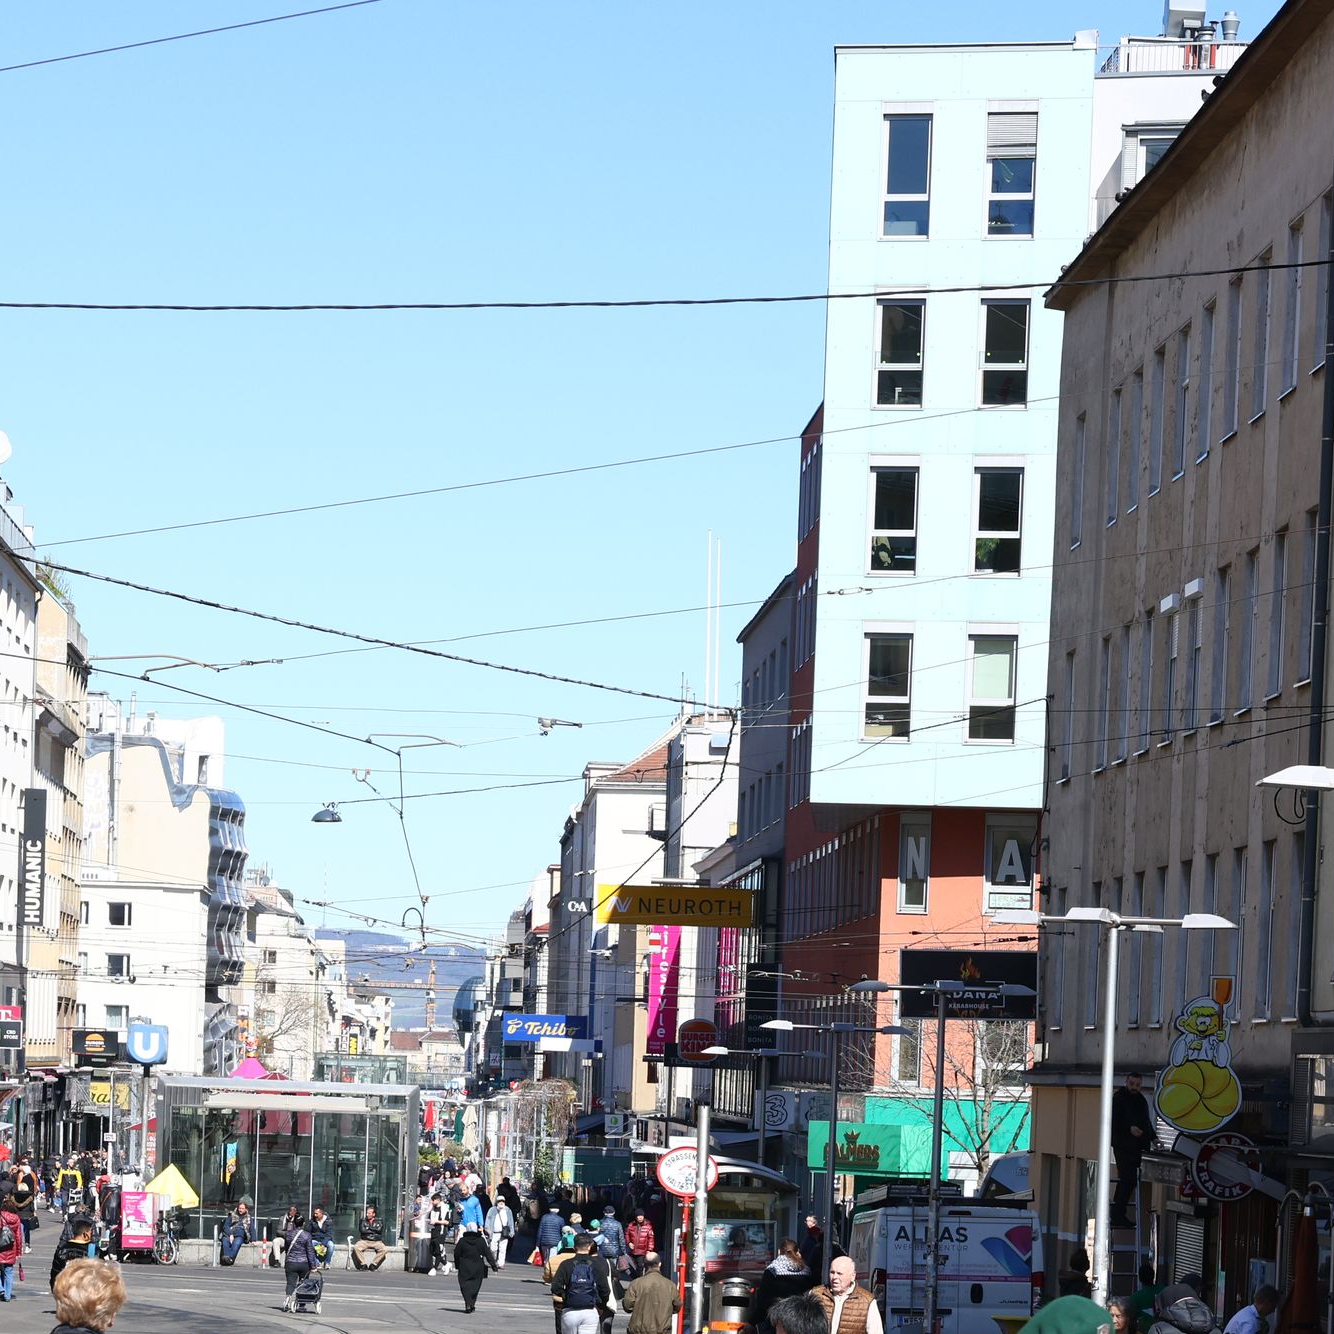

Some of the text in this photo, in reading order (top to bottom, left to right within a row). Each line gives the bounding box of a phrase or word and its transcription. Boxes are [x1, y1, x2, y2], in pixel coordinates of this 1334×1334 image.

[24, 839, 42, 923] HUMANIC
[638, 898, 741, 916] NEUROTH
[656, 925, 670, 1038] ifestyle
[524, 1021, 581, 1037] Tchibo
[134, 1032, 160, 1059] U
